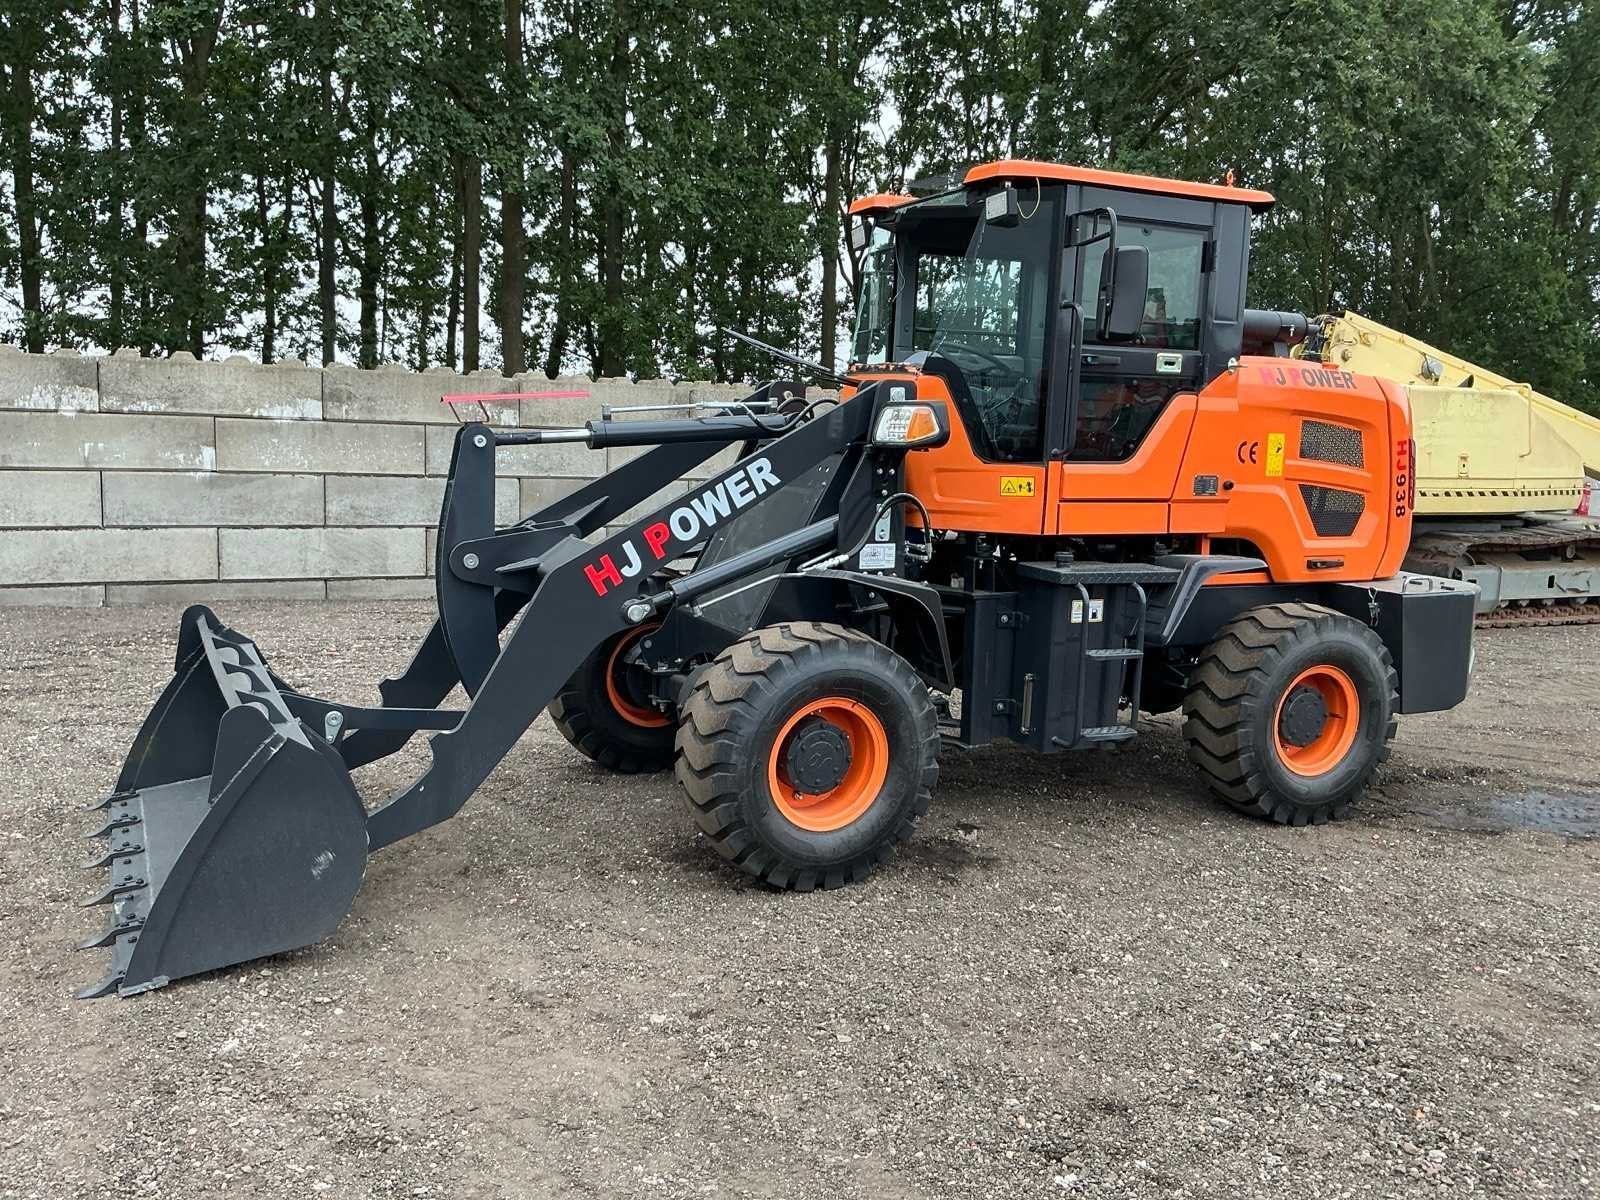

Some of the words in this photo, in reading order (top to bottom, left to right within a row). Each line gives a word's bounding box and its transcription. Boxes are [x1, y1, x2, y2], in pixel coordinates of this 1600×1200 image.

[1258, 367, 1287, 386] HJ
[1291, 367, 1358, 389] POWER
[1238, 441, 1258, 464] CE
[1395, 439, 1408, 518] HJ938
[583, 539, 642, 597] HJ
[642, 456, 782, 560] POWER
